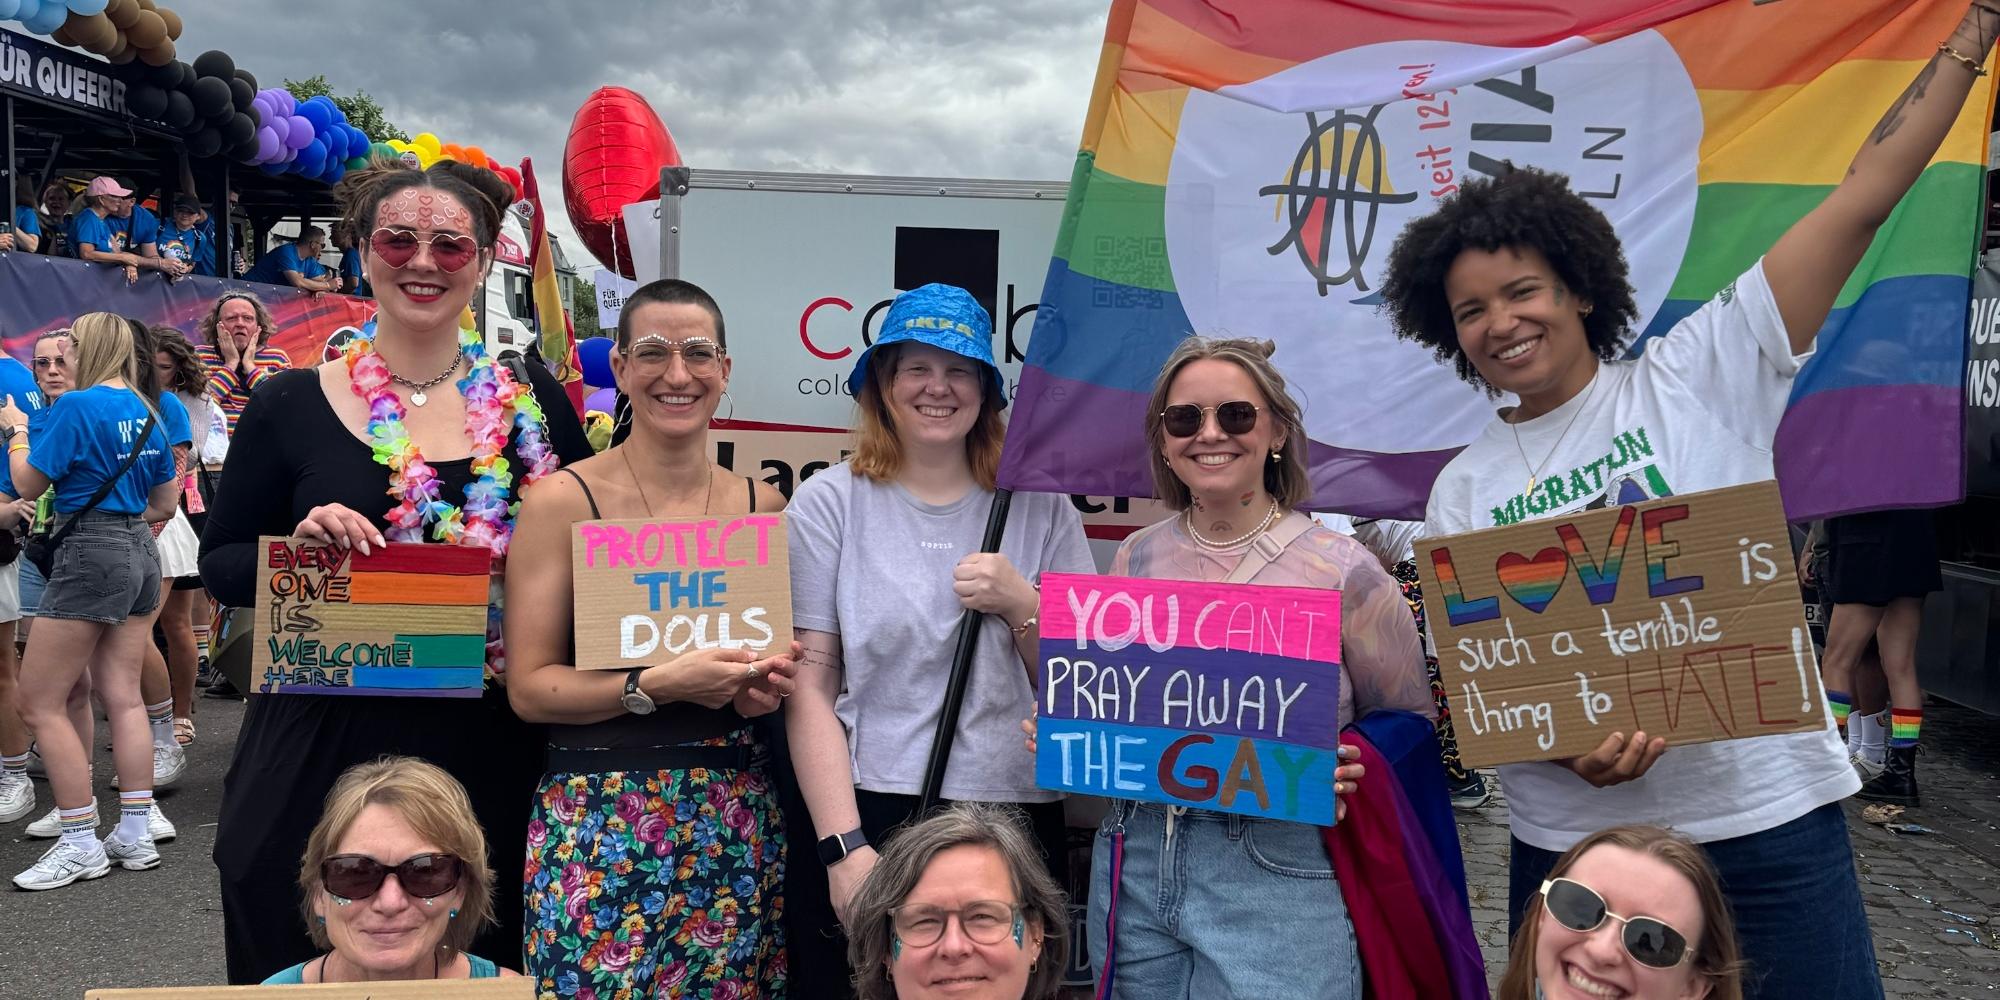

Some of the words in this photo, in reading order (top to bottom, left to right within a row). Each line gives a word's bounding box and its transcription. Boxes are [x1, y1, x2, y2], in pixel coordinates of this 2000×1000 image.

[37, 56, 138, 119] QUEERR
[1416, 144, 1459, 198] seit
[602, 288, 616, 299] FÜR
[905, 315, 976, 340] IKEA
[268, 541, 350, 577] EVERY
[580, 516, 779, 569] PROTECT
[1739, 537, 1779, 585] is
[270, 570, 352, 603] ONE
[633, 570, 728, 611] THE
[620, 607, 773, 659] DOLLS
[1067, 586, 1180, 652] YOU
[1194, 600, 1327, 661] CAN'T
[1457, 617, 1536, 673] such
[1551, 631, 1583, 656] a
[1600, 596, 1721, 657] terrible
[264, 666, 349, 687] HERE
[268, 633, 412, 668] WELCOME
[1047, 656, 1151, 723] PRAY
[1163, 669, 1308, 738] AWAY
[1462, 679, 1552, 751] thing
[1575, 671, 1613, 725] to
[1050, 730, 1147, 791] THE
[1157, 733, 1320, 817] GAY
